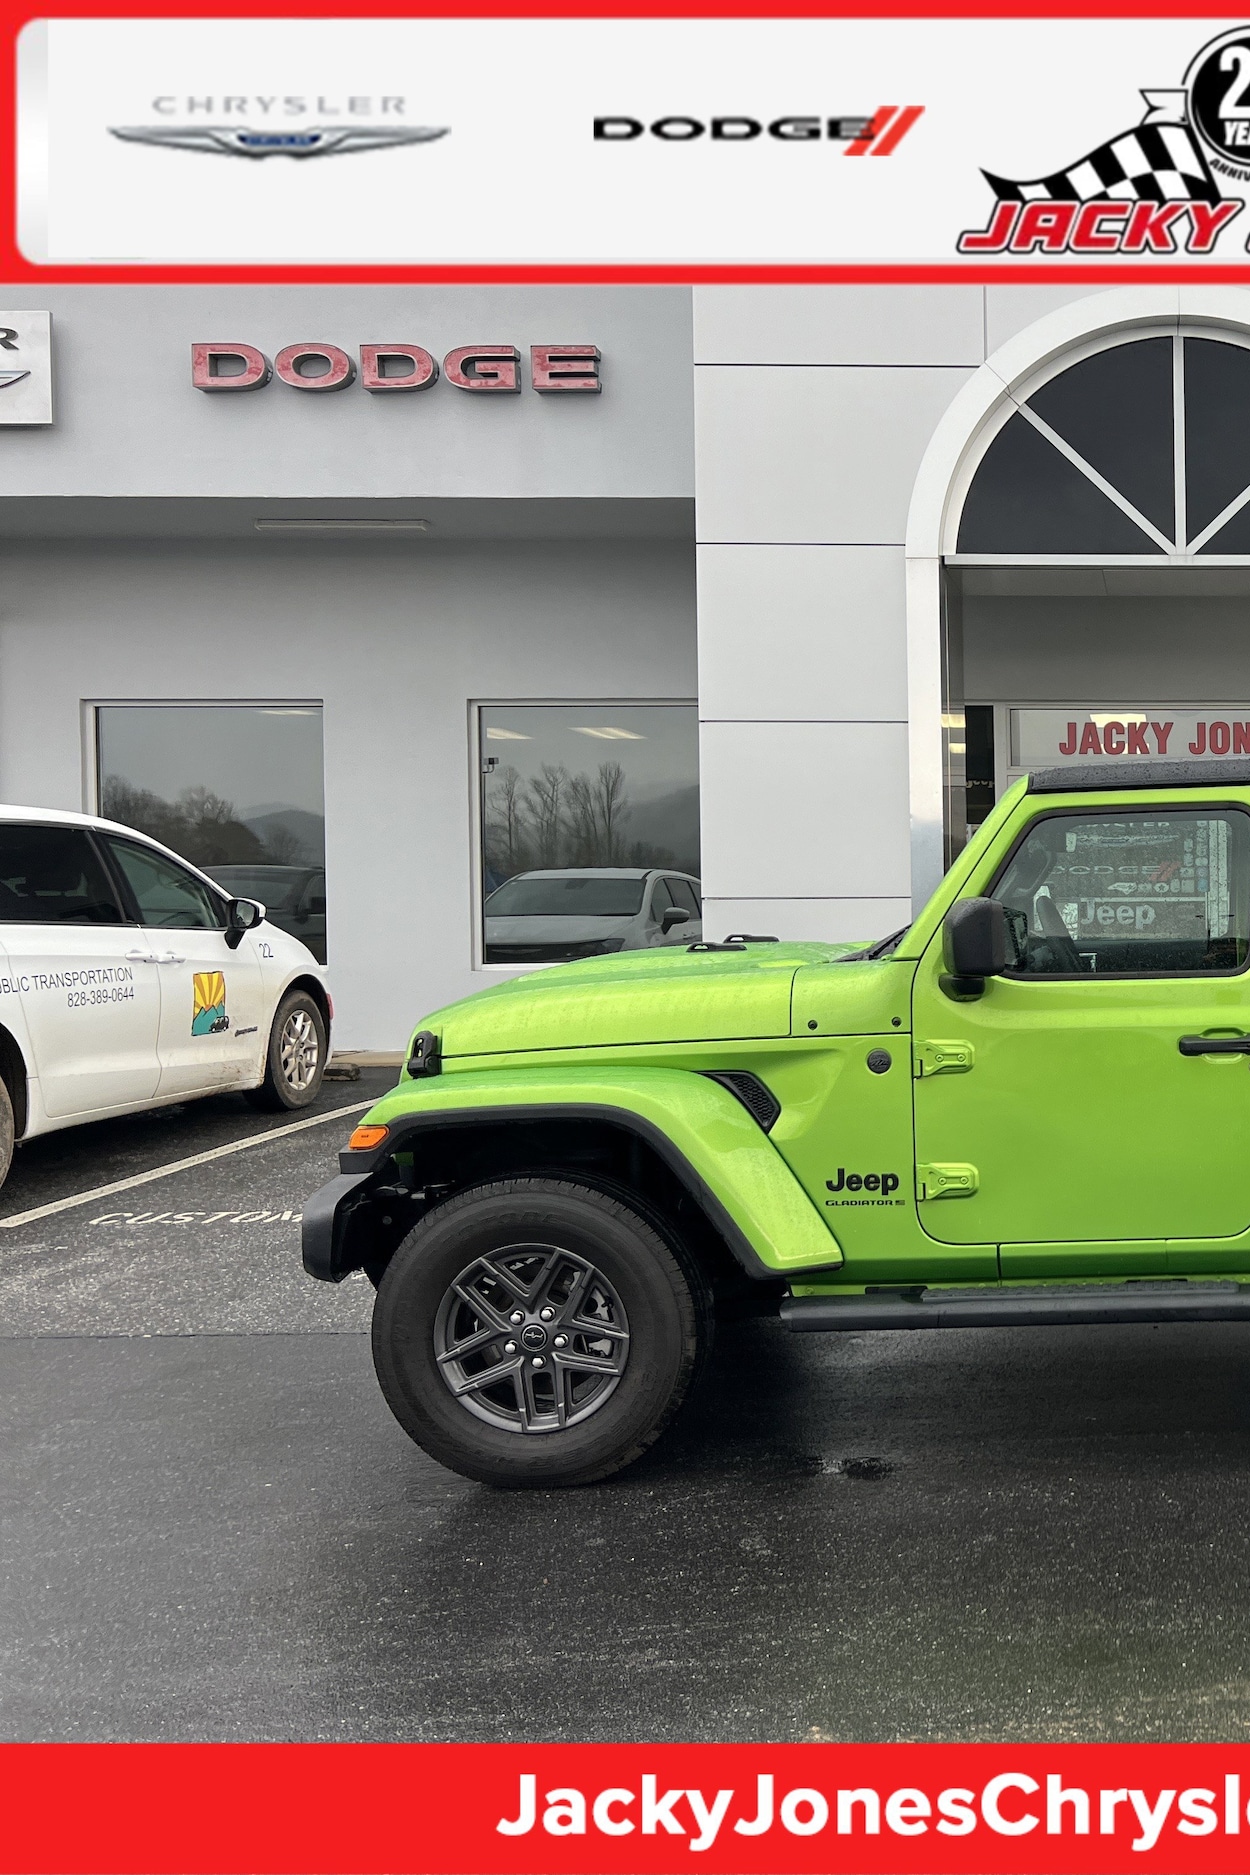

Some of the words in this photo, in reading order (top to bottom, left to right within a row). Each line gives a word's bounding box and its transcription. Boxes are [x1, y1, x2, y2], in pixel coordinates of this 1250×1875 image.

[190, 342, 603, 395] DODGE
[1058, 721, 1174, 755] JACKY
[1080, 899, 1156, 930] Jeep
[258, 942, 274, 959] 22
[0, 976, 30, 994] BLIC
[31, 966, 133, 990] TRANSPORTATION
[67, 986, 135, 1008] 828-389-0644
[825, 1168, 899, 1196] Jeep
[825, 1199, 894, 1207] GLADIATOR
